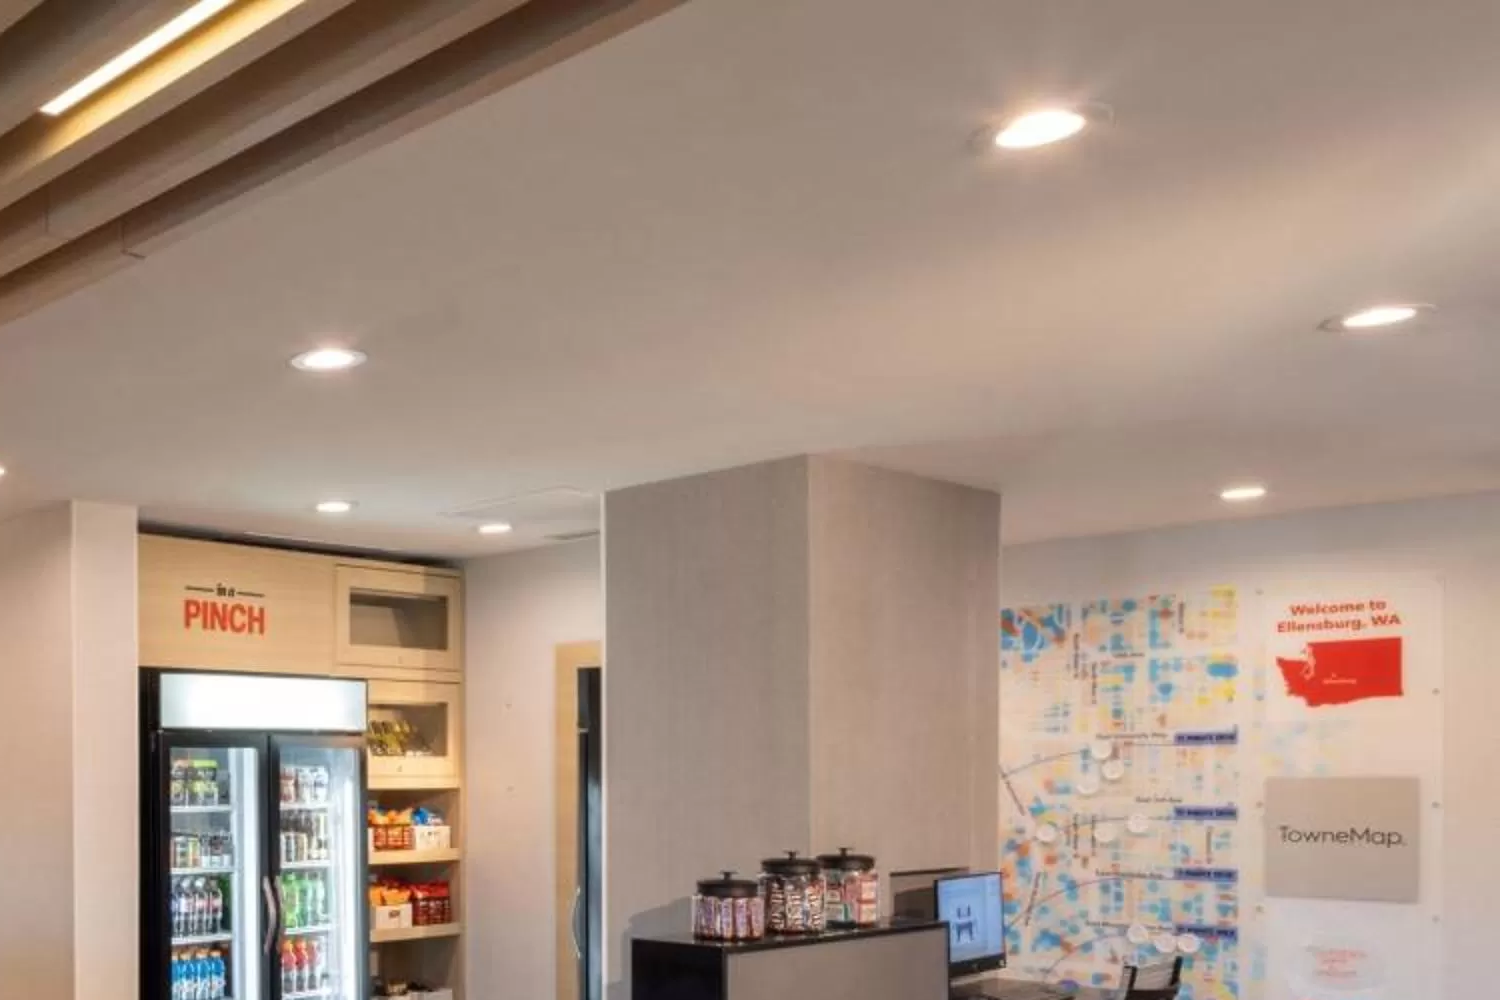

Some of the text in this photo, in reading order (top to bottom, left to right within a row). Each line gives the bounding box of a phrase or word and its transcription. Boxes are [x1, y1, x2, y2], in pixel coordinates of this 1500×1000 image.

[216, 583, 236, 598] in a
[1290, 599, 1387, 616] Welcome to
[184, 599, 266, 635] PINCH
[1277, 614, 1401, 633] Ellensburg, WA
